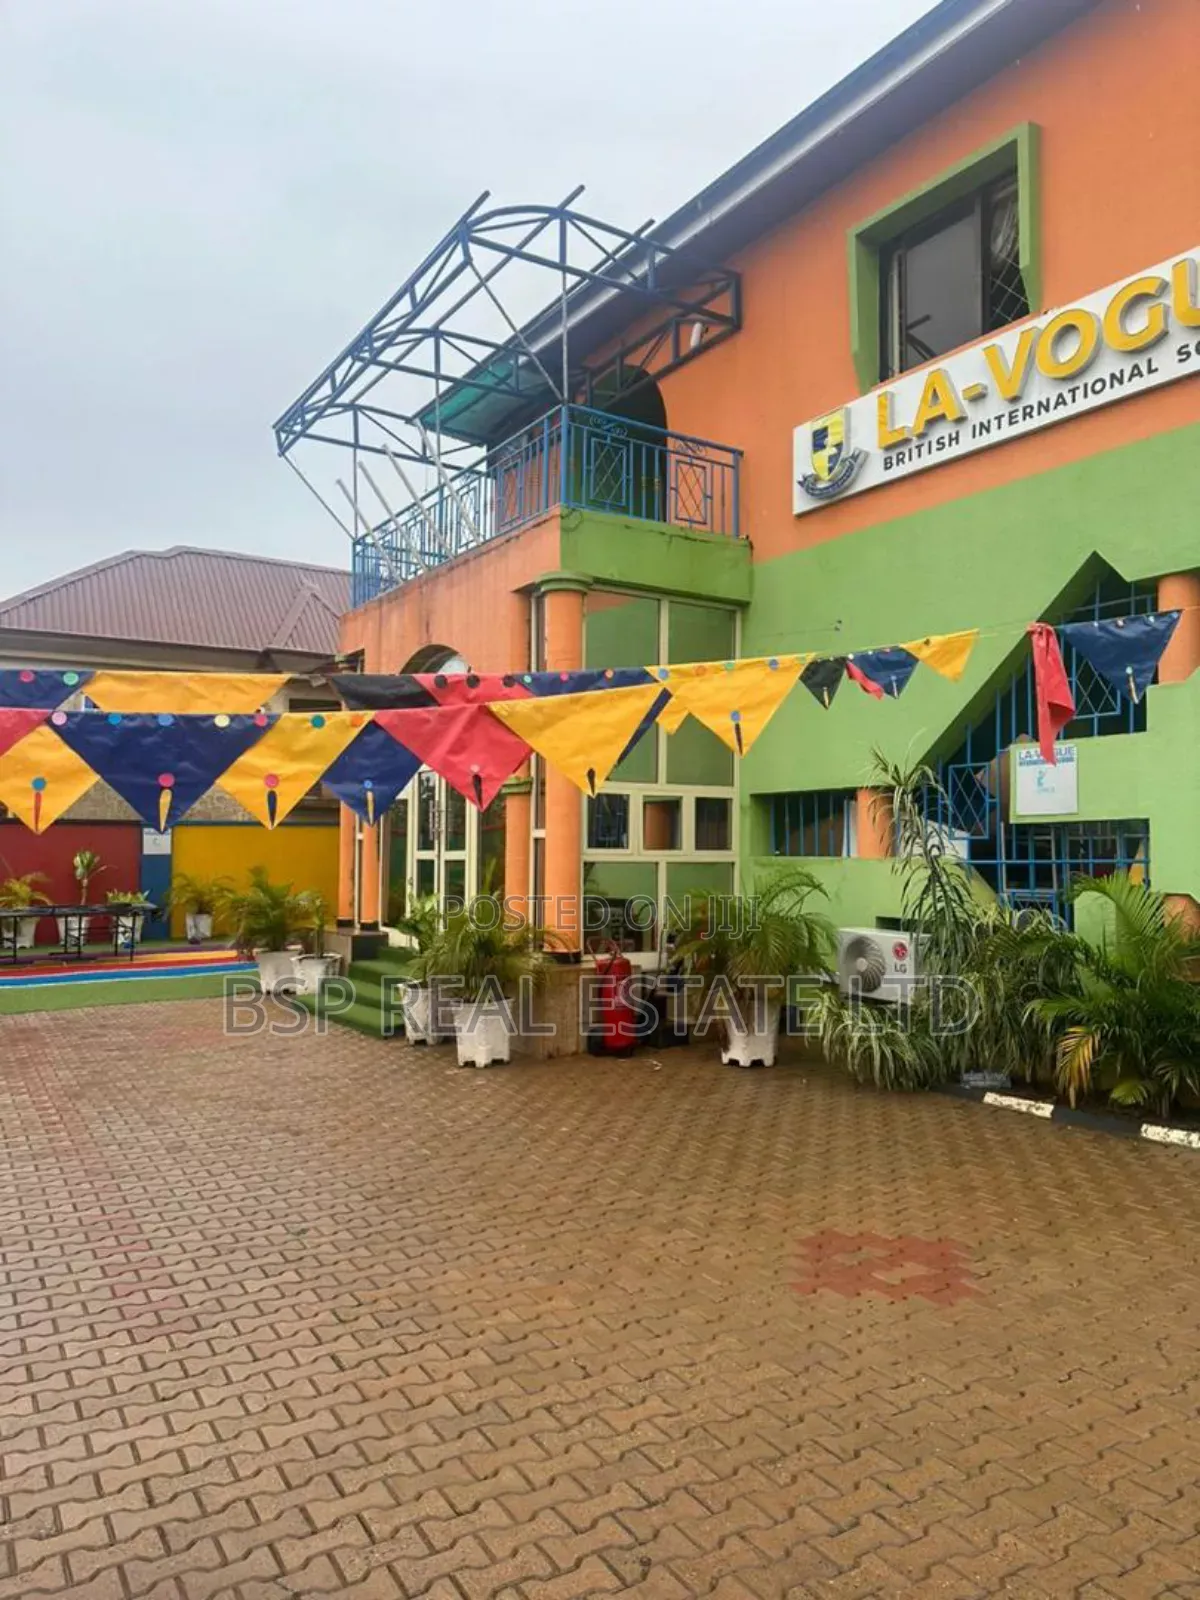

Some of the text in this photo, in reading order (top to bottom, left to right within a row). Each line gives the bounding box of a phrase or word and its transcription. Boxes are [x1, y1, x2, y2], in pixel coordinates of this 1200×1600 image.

[883, 431, 960, 470] BRITISH
[972, 357, 1158, 439] INTERNATIONAL
[894, 962, 907, 973] LG
